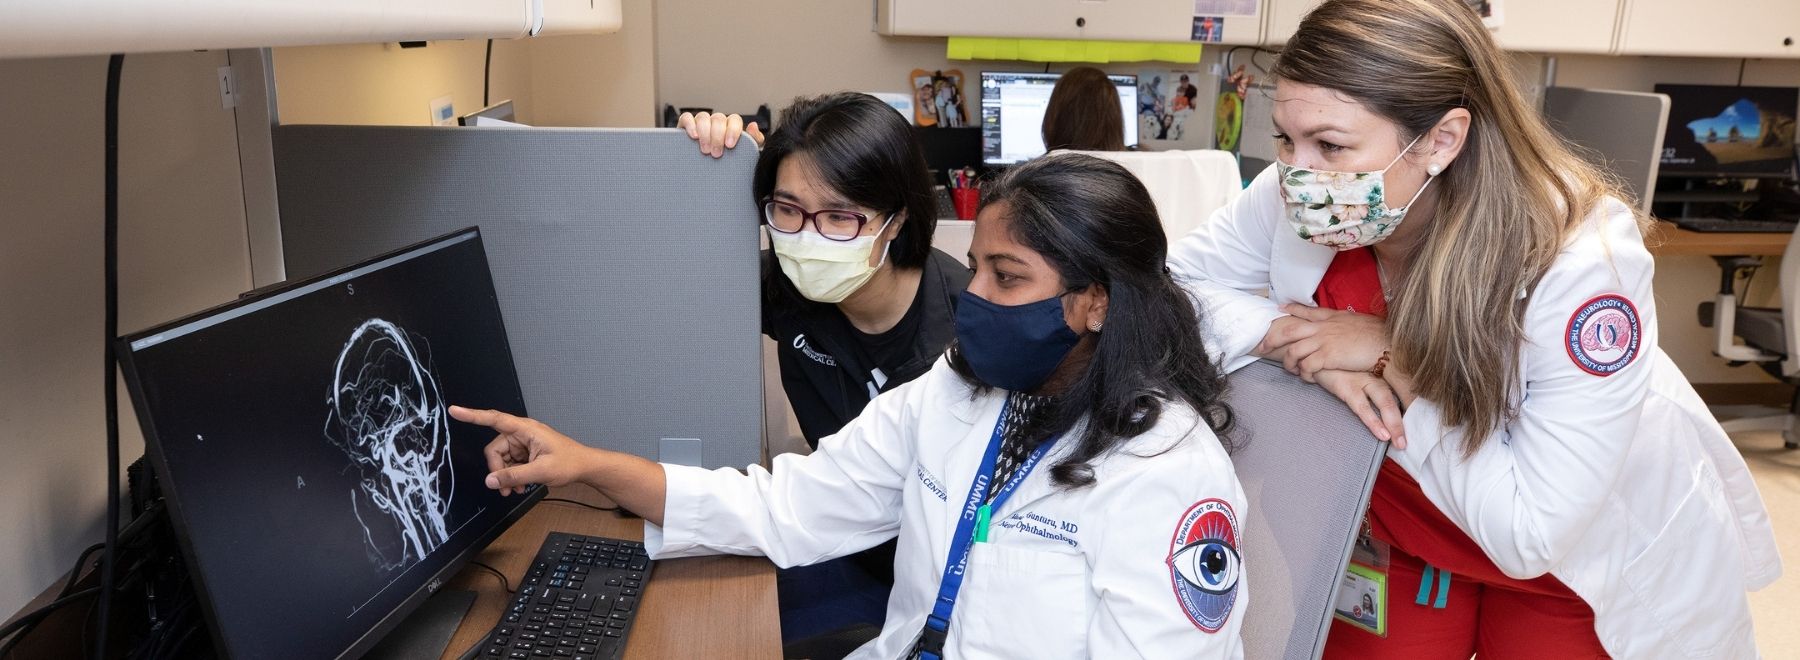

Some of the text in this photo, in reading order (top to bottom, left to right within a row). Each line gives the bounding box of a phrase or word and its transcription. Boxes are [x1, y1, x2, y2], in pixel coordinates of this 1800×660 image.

[223, 75, 231, 95] 1
[347, 283, 355, 296] S
[1577, 300, 1618, 324] NEUROLOGY
[1571, 329, 1579, 341] THE
[1571, 342, 1598, 369] UNIVERSITY
[297, 475, 306, 489] A
[1005, 450, 1041, 492] UMMC
[964, 474, 989, 520] UMMC
[1015, 521, 1078, 547] Ophthalmology
[1060, 521, 1078, 533] MD
[1175, 506, 1205, 546] DEPARTMENT
